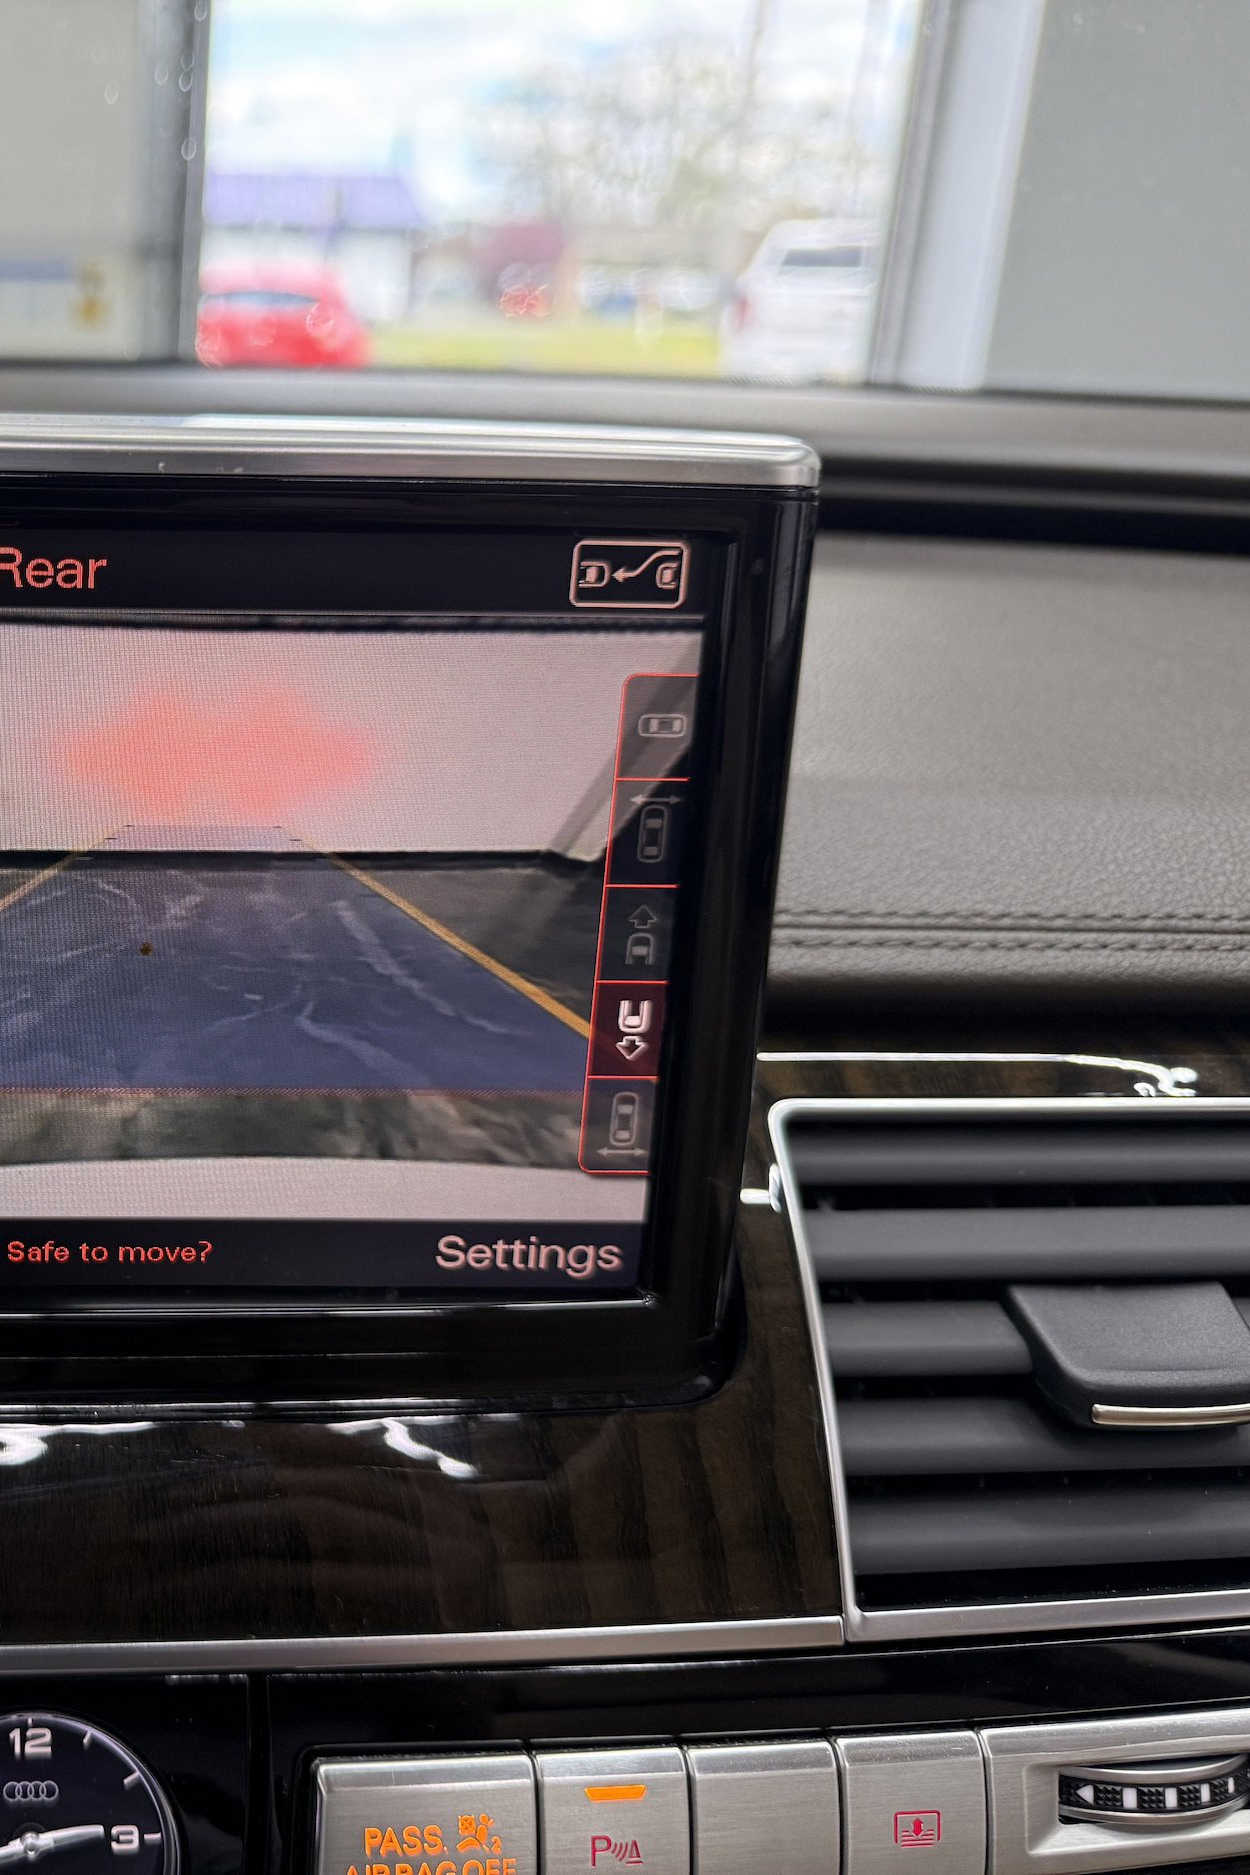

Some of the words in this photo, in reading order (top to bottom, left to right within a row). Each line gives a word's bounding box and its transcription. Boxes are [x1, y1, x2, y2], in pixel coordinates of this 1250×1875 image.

[7, 1240, 70, 1263] Safe
[79, 1241, 108, 1263] to
[118, 1240, 213, 1263] move?
[435, 1234, 623, 1280] Settings
[9, 1727, 53, 1758] 12
[111, 1824, 140, 1852] 3
[364, 1825, 448, 1857] PASS.
